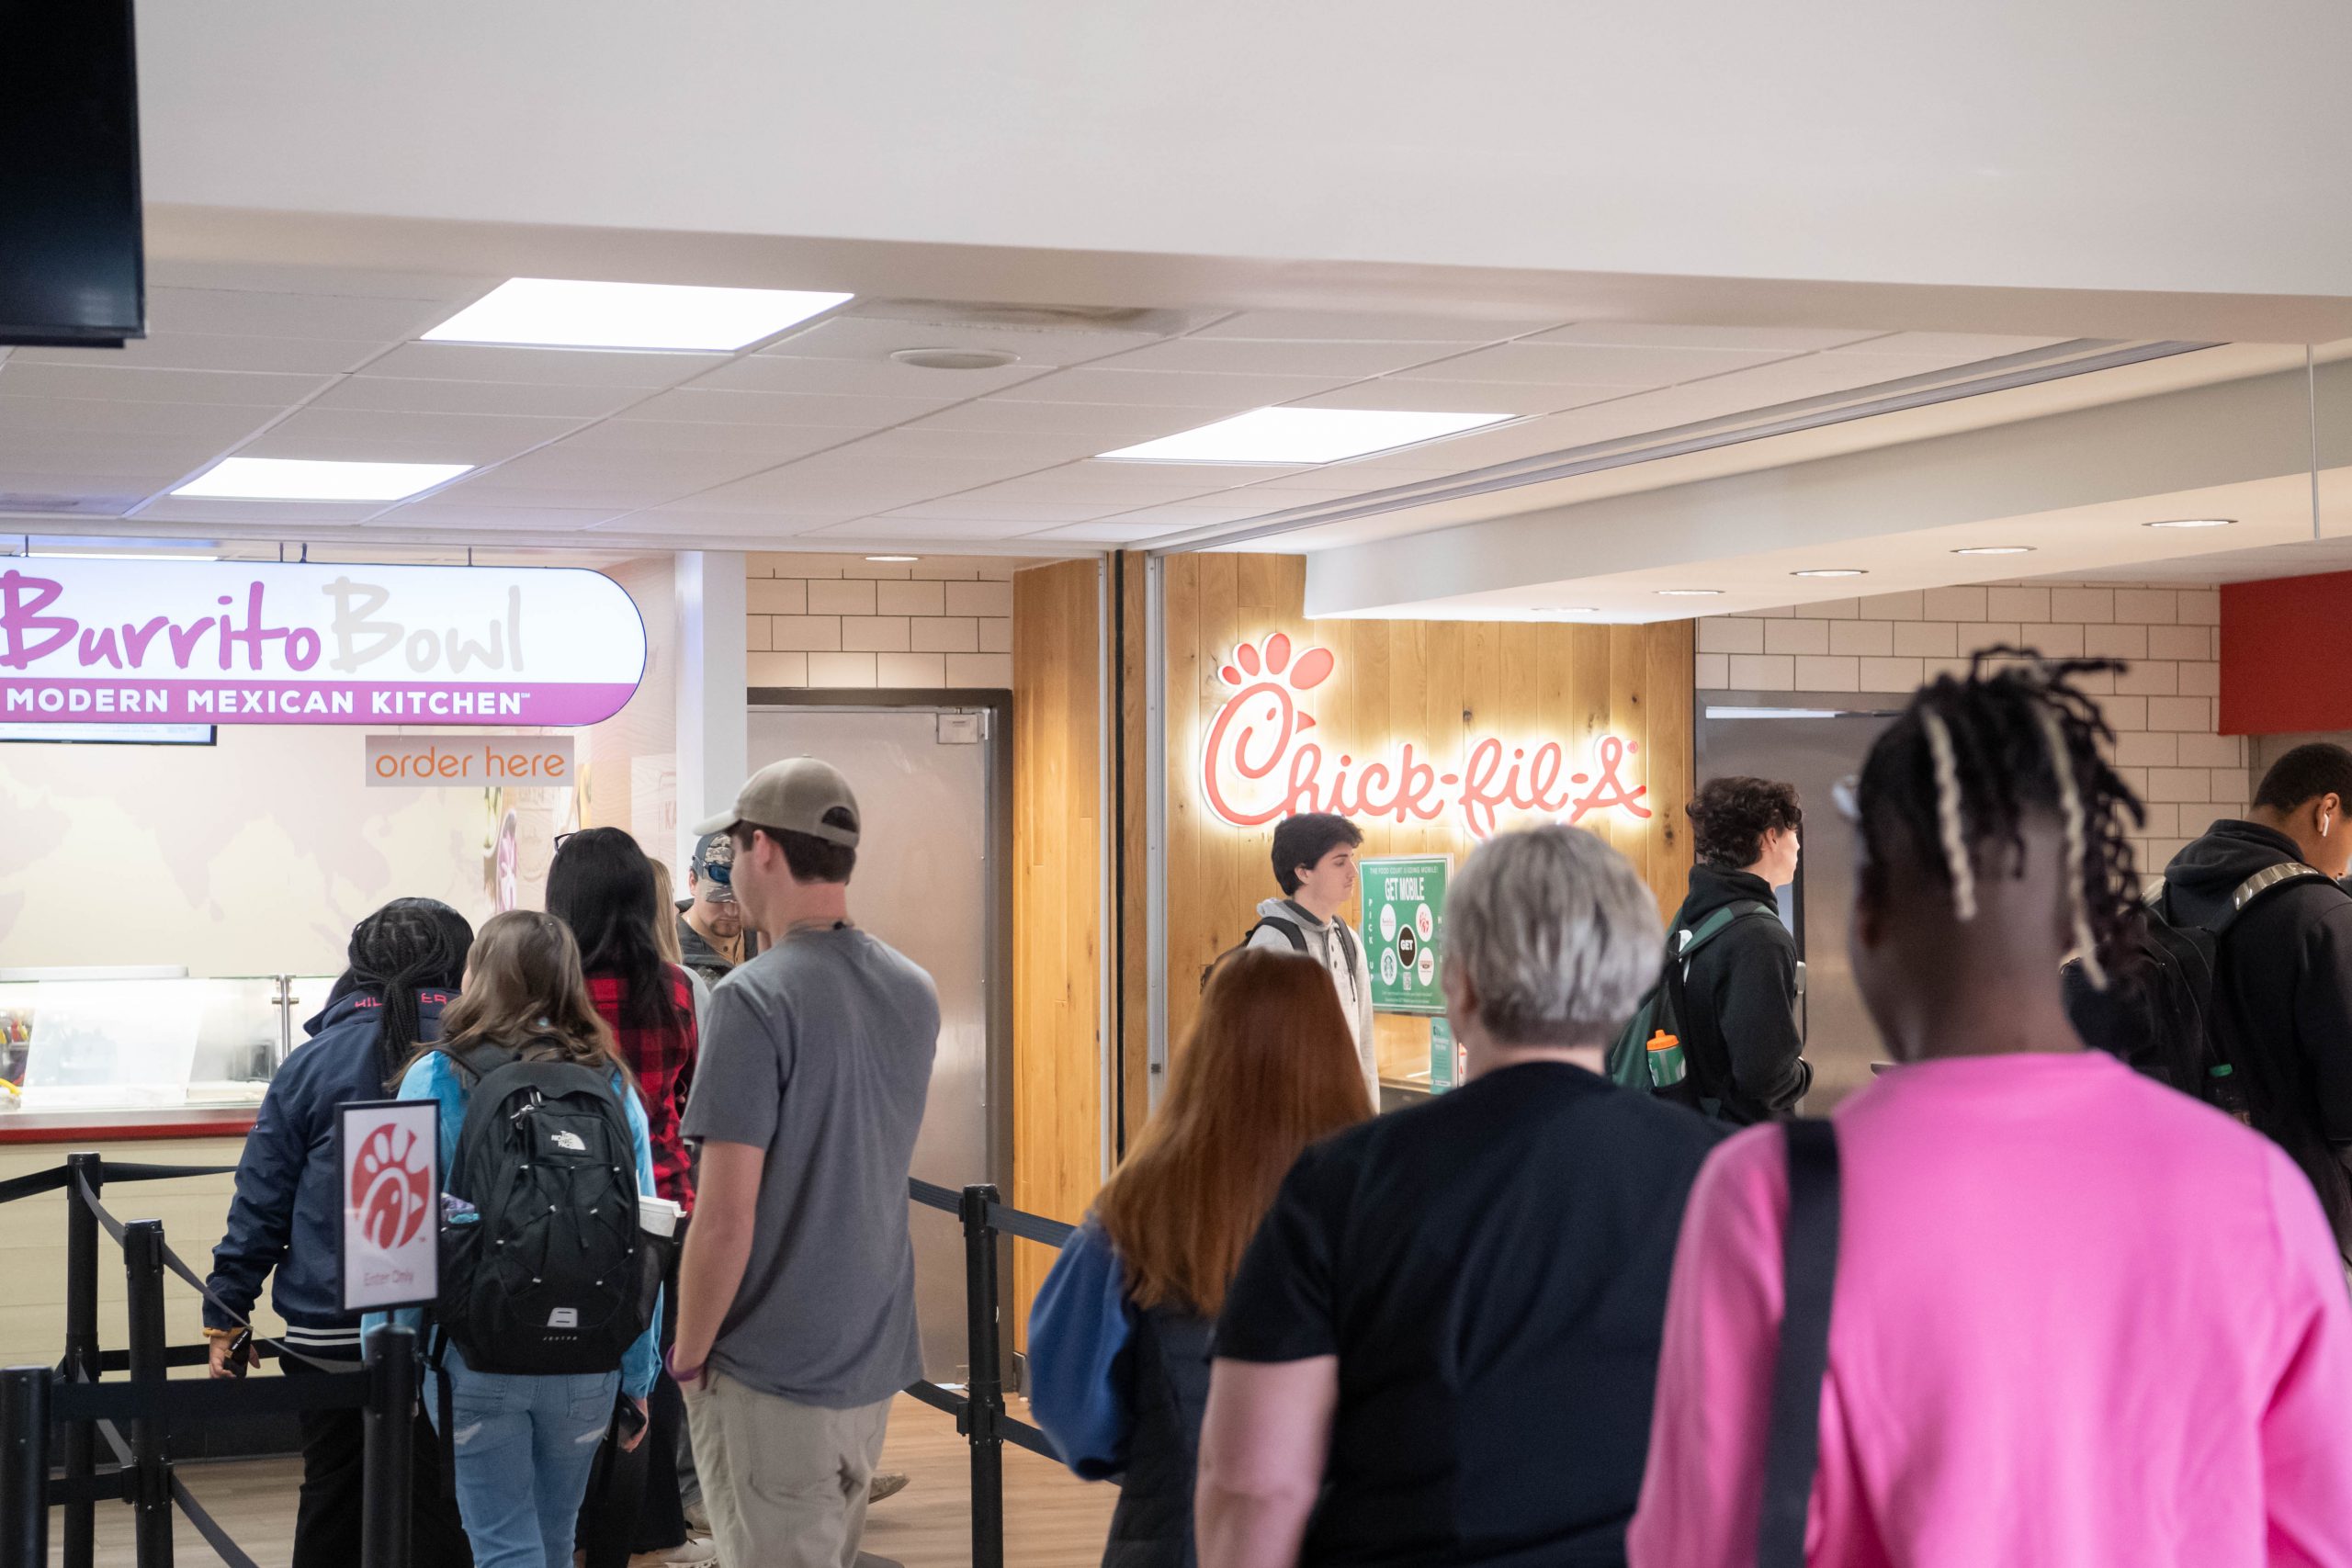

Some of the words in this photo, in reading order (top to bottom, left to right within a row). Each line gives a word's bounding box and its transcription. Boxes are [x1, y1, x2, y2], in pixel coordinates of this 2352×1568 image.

[6, 688, 168, 713] MODERN
[187, 689, 353, 714] MEXICAN
[372, 691, 521, 715] KITCHEN
[376, 746, 472, 778] order
[486, 746, 565, 778] here
[1385, 877, 1398, 901] GET
[1399, 877, 1425, 901] MOBILE
[1400, 939, 1413, 951] GET
